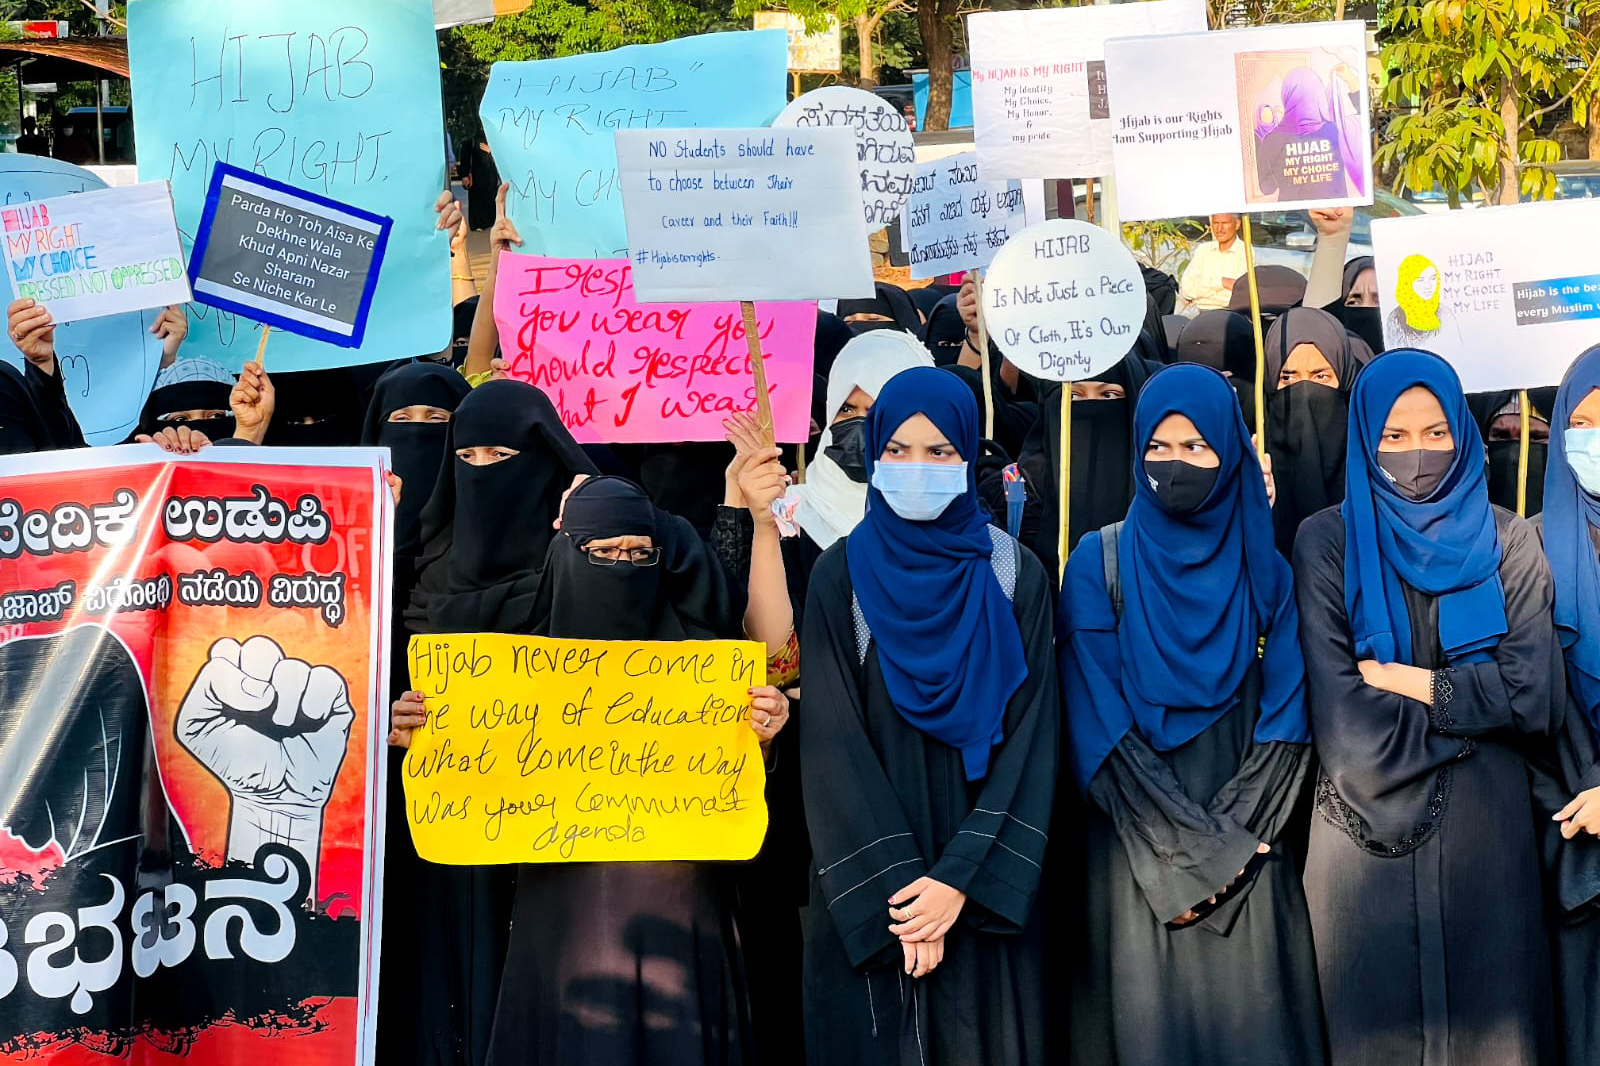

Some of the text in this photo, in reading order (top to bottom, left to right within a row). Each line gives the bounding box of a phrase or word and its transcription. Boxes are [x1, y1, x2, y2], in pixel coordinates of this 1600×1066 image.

[190, 27, 373, 113] HIJAB
[988, 68, 1016, 81] HIJAB
[1020, 67, 1030, 77] IS
[1053, 61, 1085, 75] RIGHT
[1019, 84, 1053, 95] Identity
[499, 106, 544, 149] MY
[1119, 110, 1223, 130] Hijab is our Rights
[1138, 128, 1199, 144] Supporting
[1201, 123, 1233, 139] Hijab
[674, 138, 726, 158] Students
[738, 137, 774, 157] should
[786, 137, 815, 157] have
[1028, 132, 1052, 143] pride
[1285, 139, 1331, 156] HIJAB
[1283, 162, 1339, 177] MY CHOICE
[1285, 153, 1333, 166] MY RIGHT
[648, 169, 662, 191] to
[669, 169, 704, 192] choose
[713, 169, 755, 190] between
[1293, 173, 1333, 186] MY LIFE
[2, 204, 51, 232] HIJAB
[231, 194, 375, 251] Parda Ho Toh Aisa Ke
[703, 212, 723, 227] and
[732, 211, 752, 226] their
[7, 223, 84, 258] MY RIGHT
[256, 221, 342, 259] Dekhne Wala
[1035, 234, 1090, 259] HIJAB
[12, 246, 98, 281] MY CHOICE
[239, 235, 350, 280] Khud Apni Nazar
[1447, 251, 1494, 267] HIJAB
[80, 270, 108, 293] NOT
[111, 257, 183, 290] OPPRESSED
[264, 262, 316, 288] Sharam
[519, 267, 566, 296] I
[233, 271, 337, 314] Se Niche Kar Le
[992, 288, 1007, 308] Is
[1013, 284, 1042, 305] Not
[1046, 280, 1078, 302] Just
[1085, 287, 1095, 297] a
[1517, 287, 1546, 300] Hijab
[1549, 285, 1558, 297] is
[1562, 283, 1580, 295] the
[1517, 306, 1548, 318] every
[1552, 301, 1593, 315] Muslim
[518, 303, 775, 358] you wear you
[1029, 325, 1067, 344] Cloth,
[1100, 317, 1131, 336] Our
[629, 346, 773, 389] respect
[1038, 350, 1091, 377] Dignity
[559, 387, 608, 430] hat
[166, 485, 327, 540] ಉಡುಪಿ
[0, 585, 72, 620] ಜಾಬ್
[181, 571, 259, 603] ನಡೆಯ
[411, 638, 492, 694] Hijab
[512, 645, 608, 678] never
[731, 648, 755, 686] in
[563, 686, 593, 726] of
